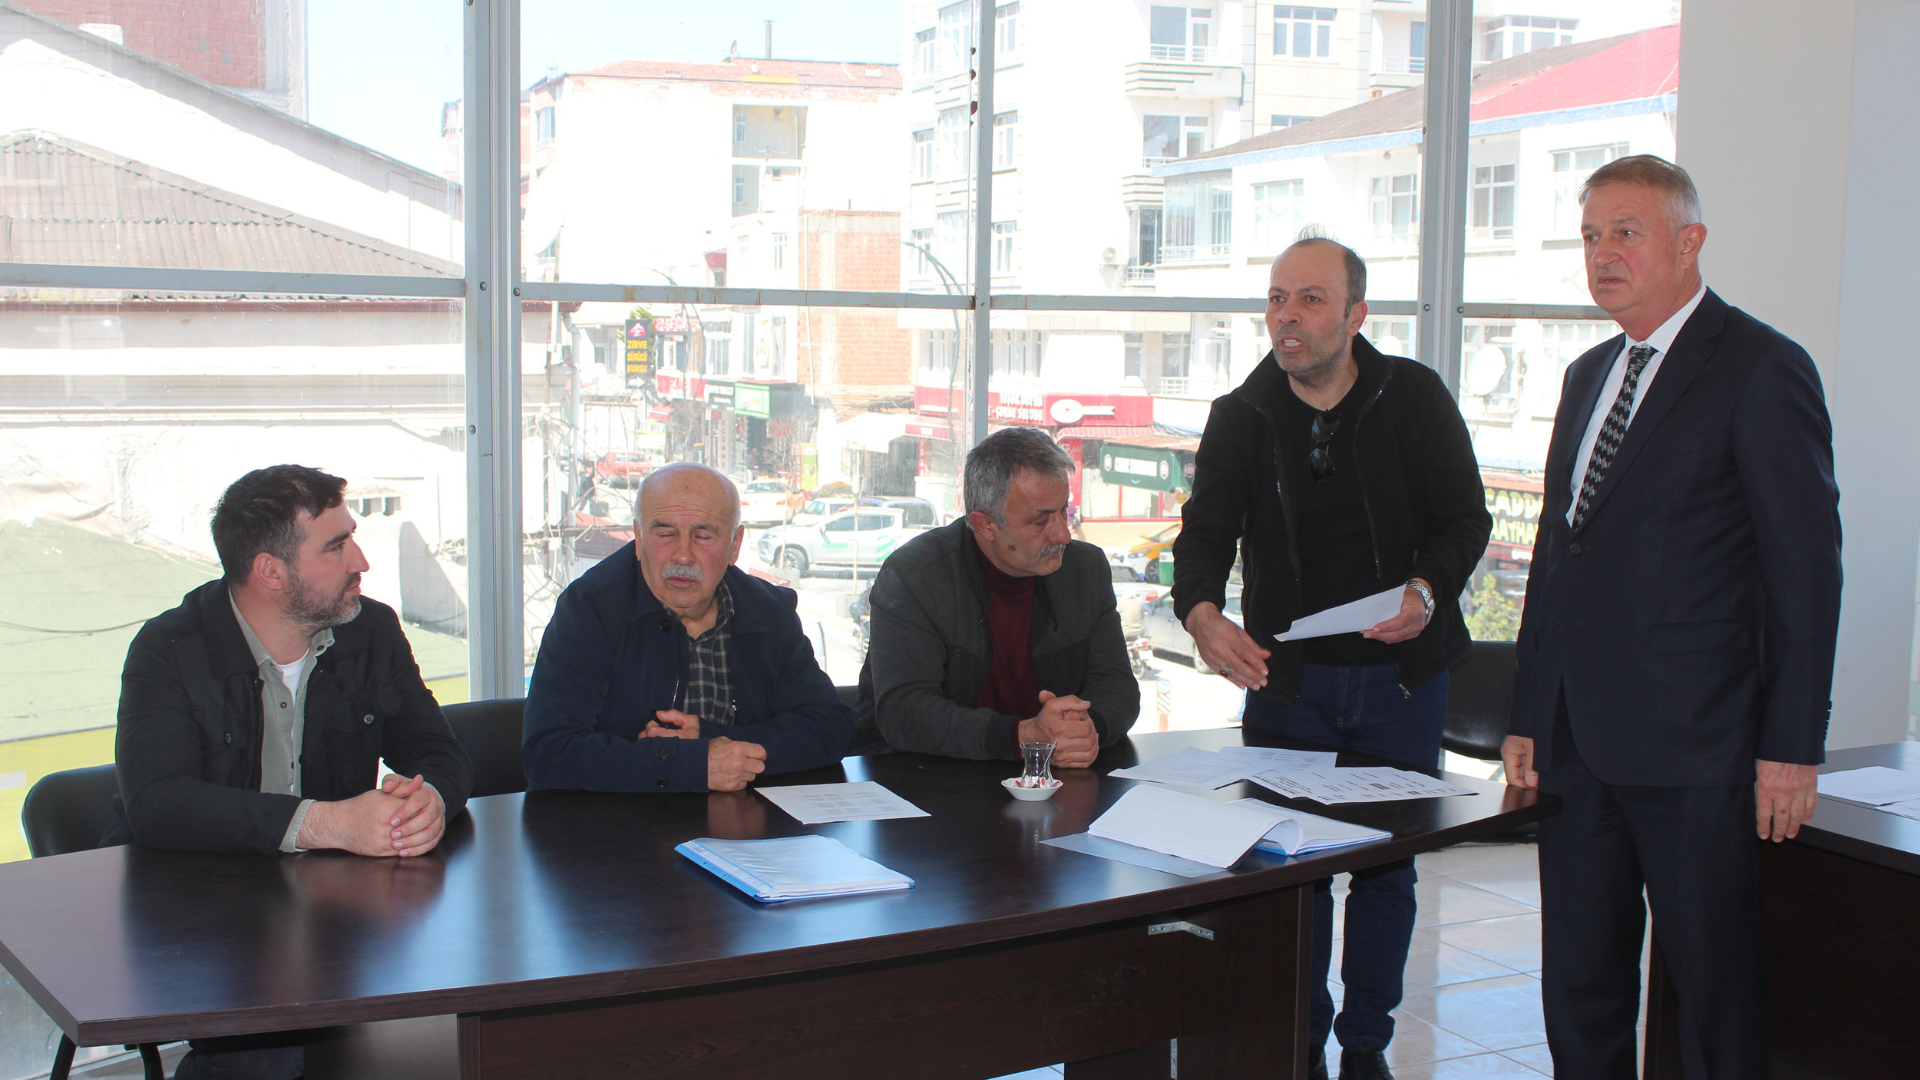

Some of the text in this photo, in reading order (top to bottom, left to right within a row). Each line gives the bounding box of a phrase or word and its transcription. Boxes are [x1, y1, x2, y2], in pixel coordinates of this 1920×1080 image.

[627, 340, 647, 349] ZİRVE
[627, 351, 647, 362] SÜRÜCÜ
[627, 364, 647, 373] KURSU
[1490, 517, 1538, 544] AATHA
